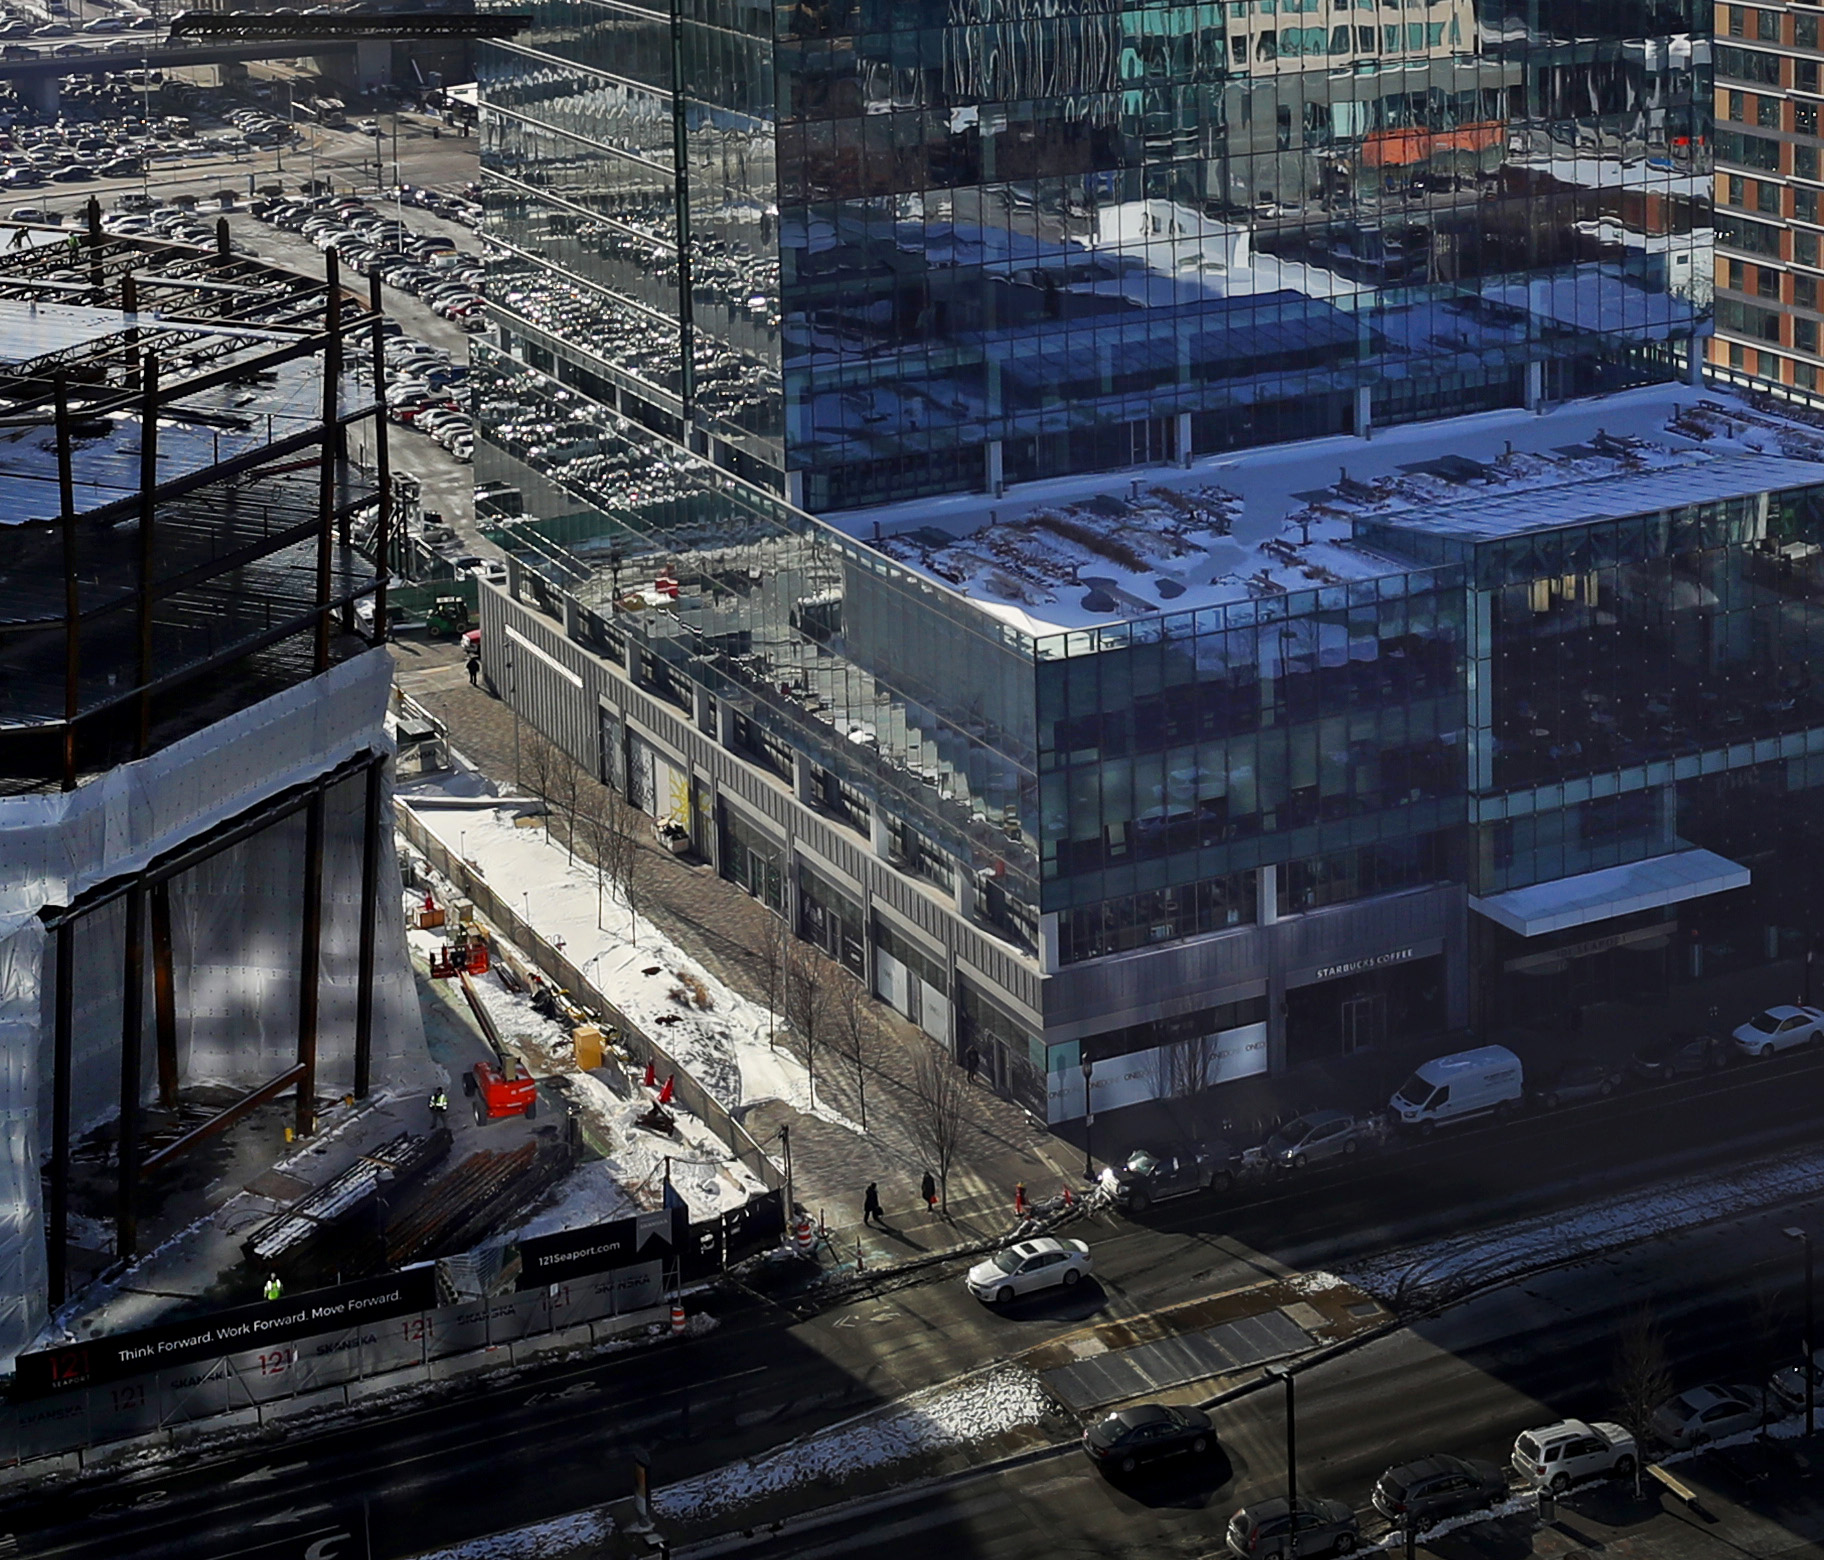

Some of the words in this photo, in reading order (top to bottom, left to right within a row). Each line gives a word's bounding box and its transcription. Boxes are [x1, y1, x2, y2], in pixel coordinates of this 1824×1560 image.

[1316, 958, 1375, 979] STARBUCKS
[1377, 948, 1413, 966] COFFEE
[538, 1241, 622, 1267] 121Seaport.com
[119, 1346, 154, 1363] Think
[158, 1332, 214, 1358] Forward.
[217, 1324, 251, 1342] Work
[254, 1306, 309, 1333] Forward.
[312, 1303, 345, 1320] Move
[349, 1290, 402, 1312] Forward.
[402, 1316, 434, 1343] 121
[316, 1333, 377, 1356] SKANSKA
[48, 1349, 91, 1381] 121
[258, 1348, 294, 1377] 121
[112, 1385, 145, 1412] 121
